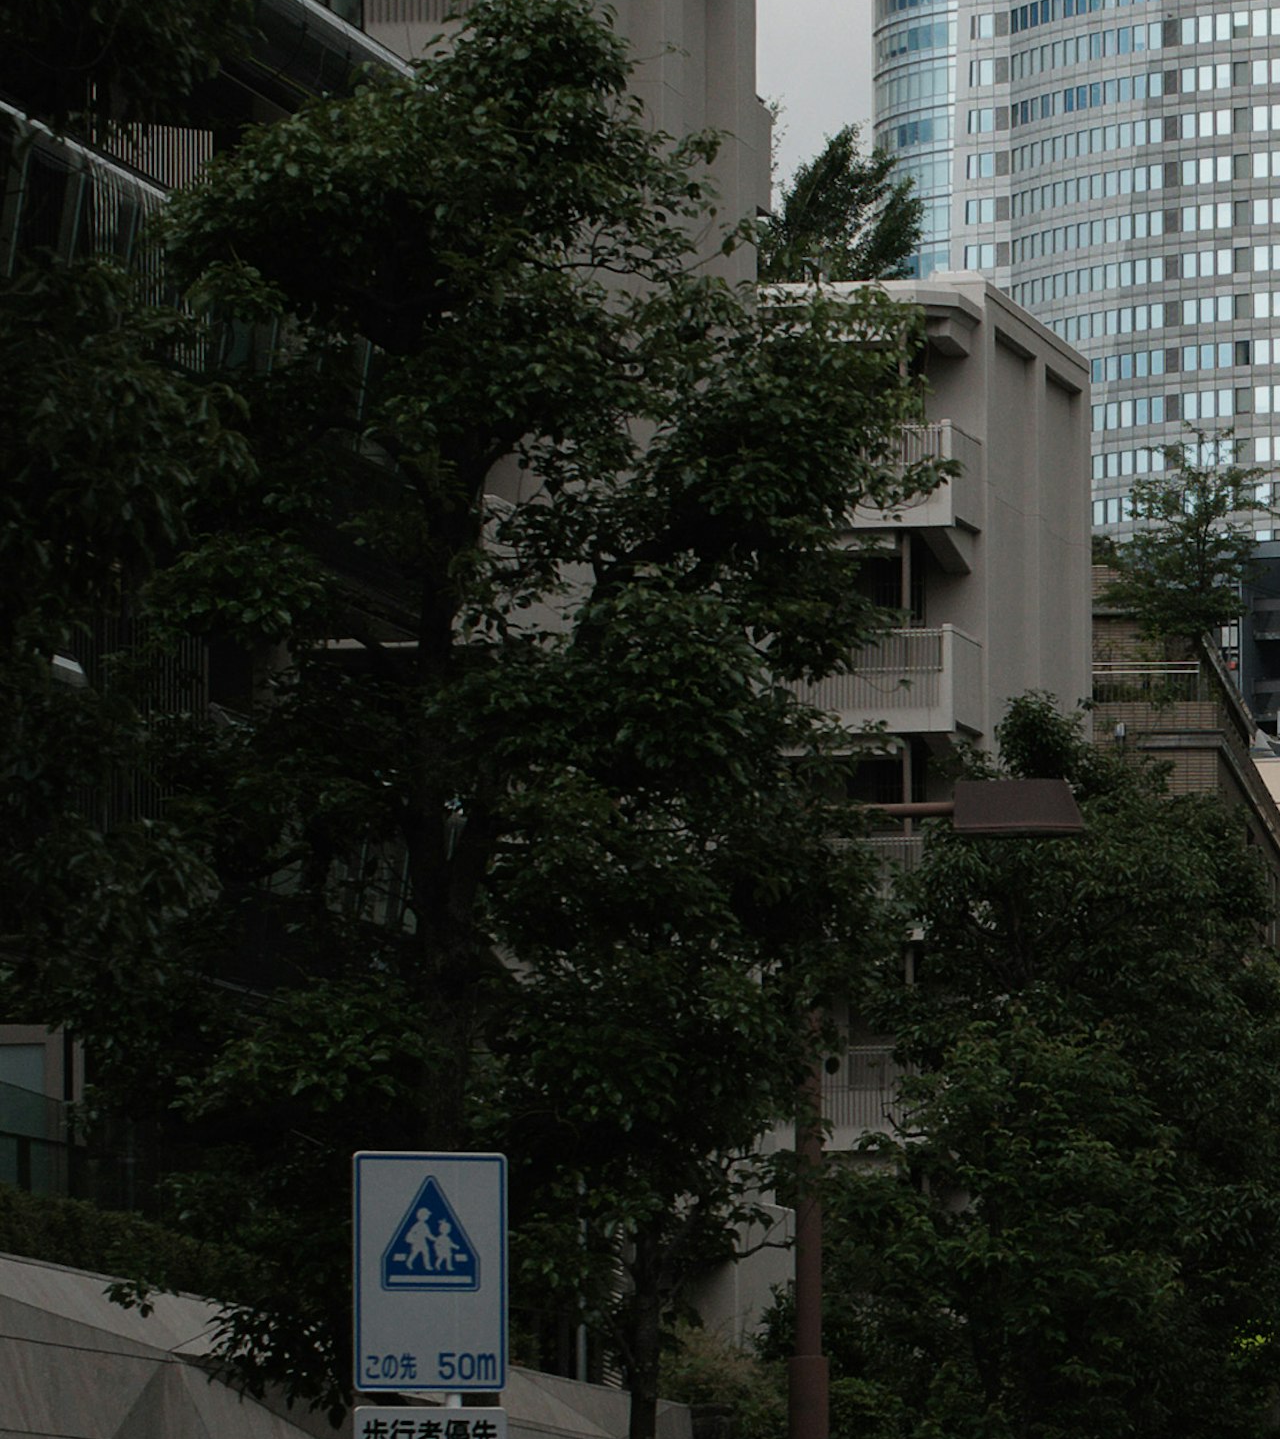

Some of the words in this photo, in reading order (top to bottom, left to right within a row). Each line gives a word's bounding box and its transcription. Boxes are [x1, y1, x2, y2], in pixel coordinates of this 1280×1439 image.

[365, 1352, 417, 1380] この先
[438, 1352, 497, 1380] 50m
